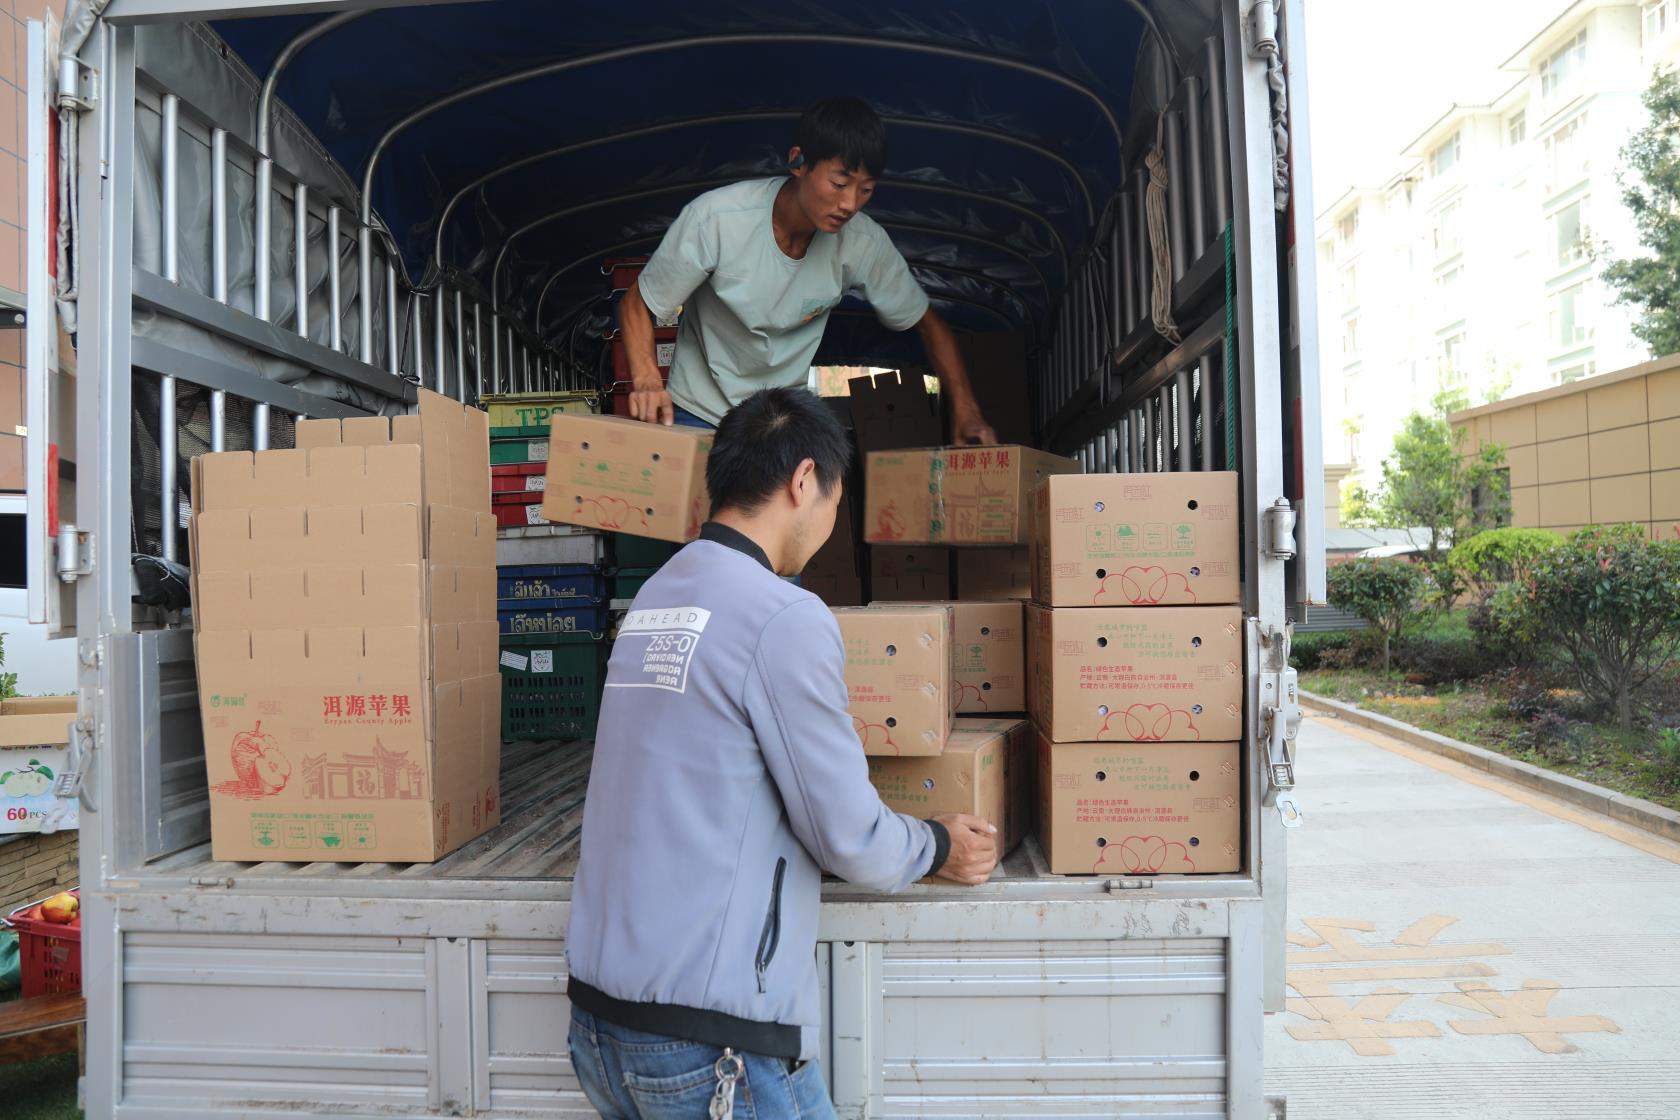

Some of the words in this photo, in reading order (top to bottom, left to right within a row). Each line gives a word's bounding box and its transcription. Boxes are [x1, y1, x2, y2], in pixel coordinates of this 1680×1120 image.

[322, 694, 411, 717] 洱源苹果
[7, 807, 28, 821] 60
